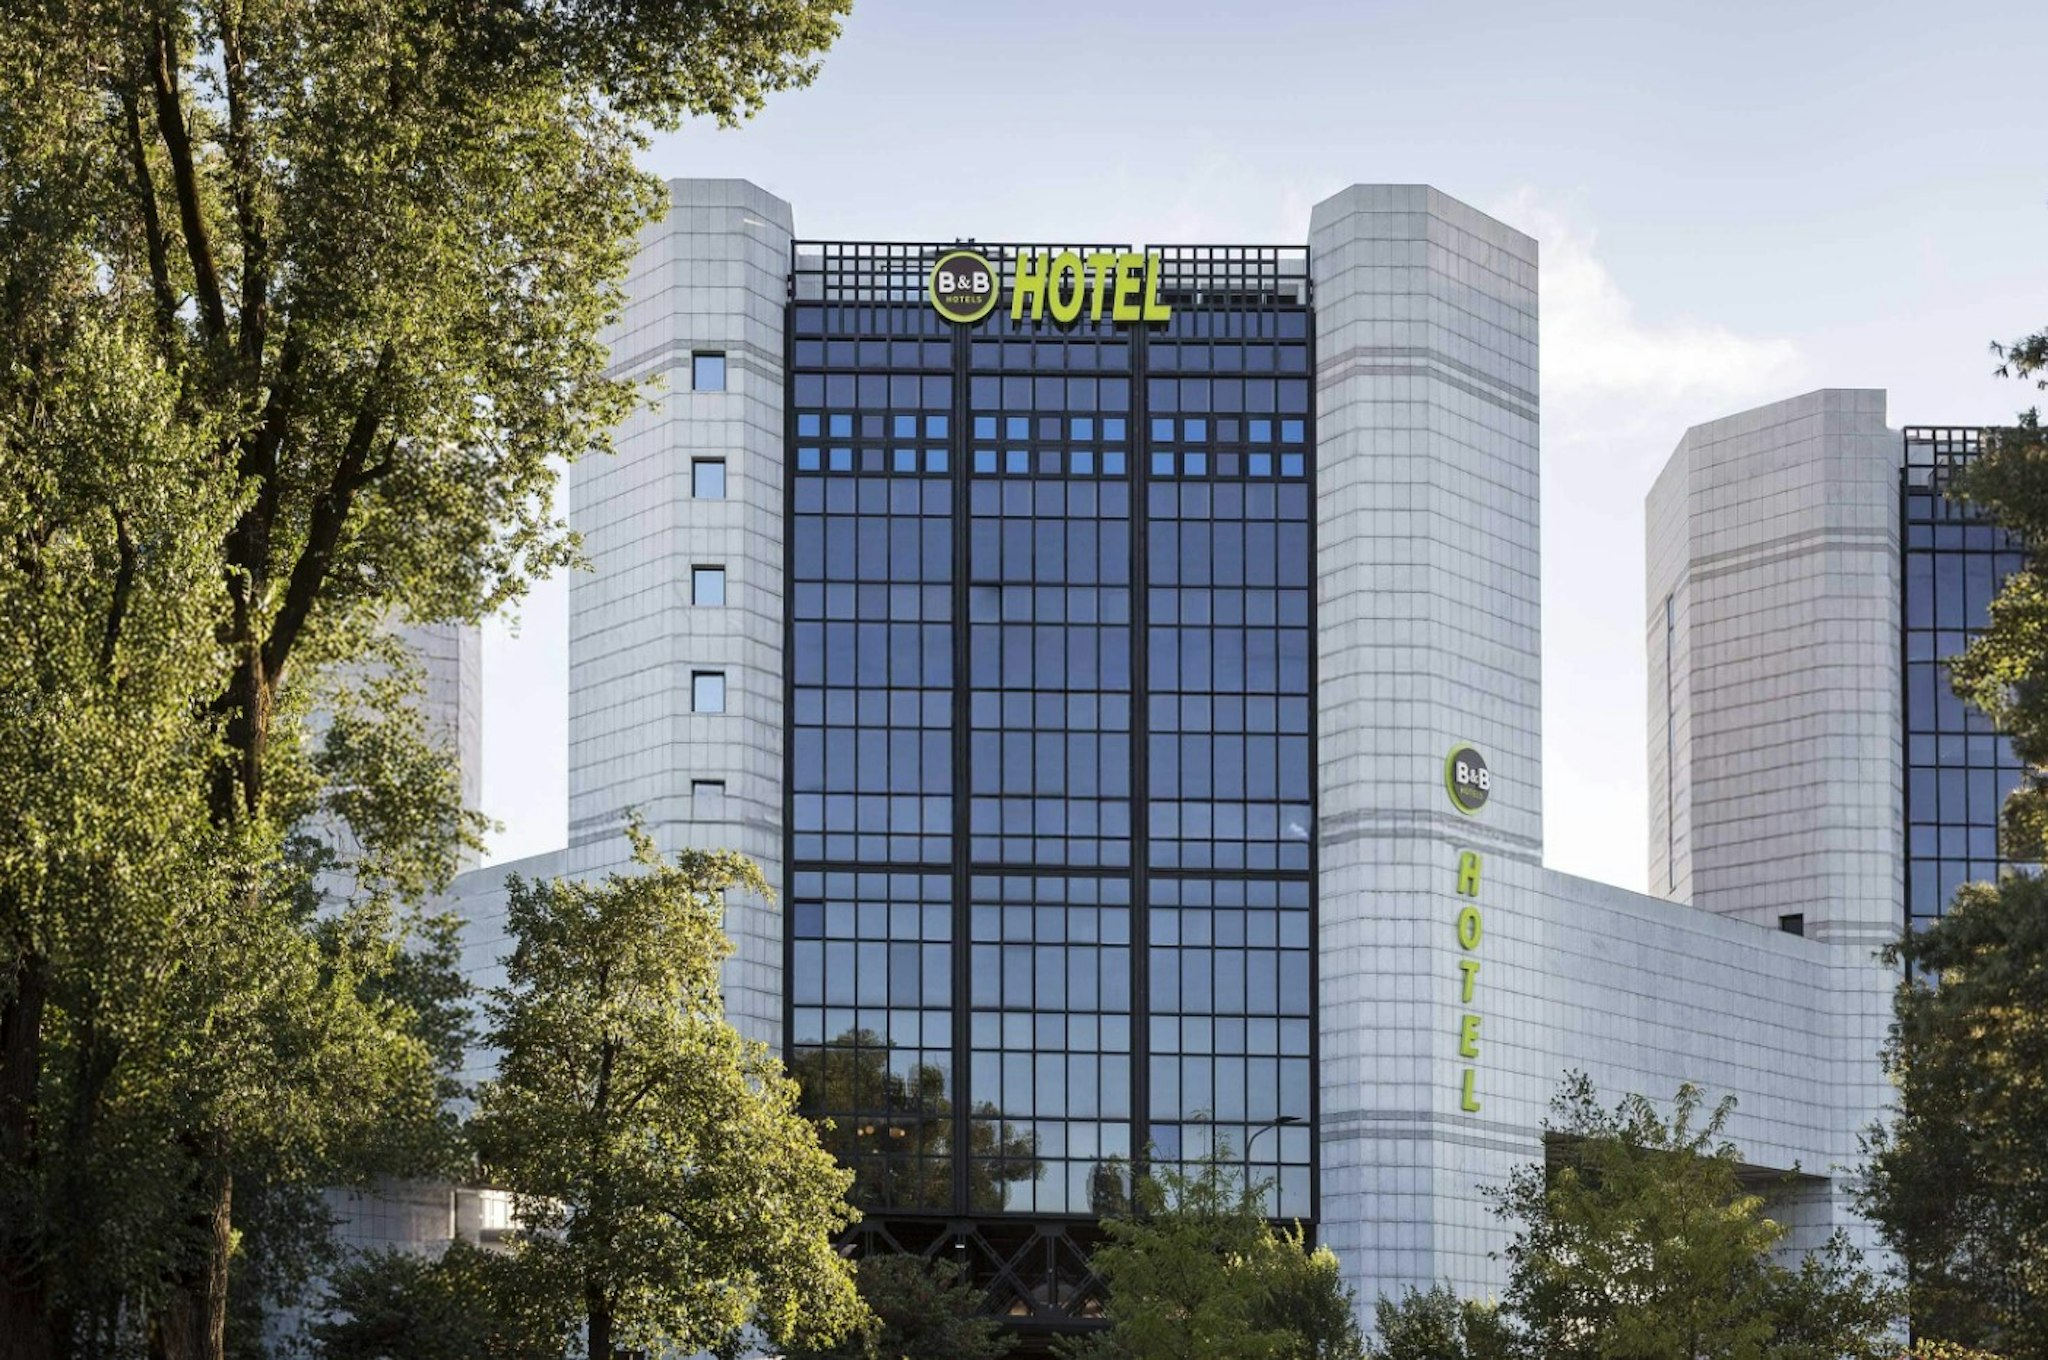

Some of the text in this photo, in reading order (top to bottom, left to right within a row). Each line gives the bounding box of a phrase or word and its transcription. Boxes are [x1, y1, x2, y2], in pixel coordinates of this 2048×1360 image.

[939, 271, 990, 293] B&B
[1011, 252, 1171, 322] HOTEL
[1456, 761, 1490, 790] B&B
[1457, 851, 1482, 1112] HOTEL
